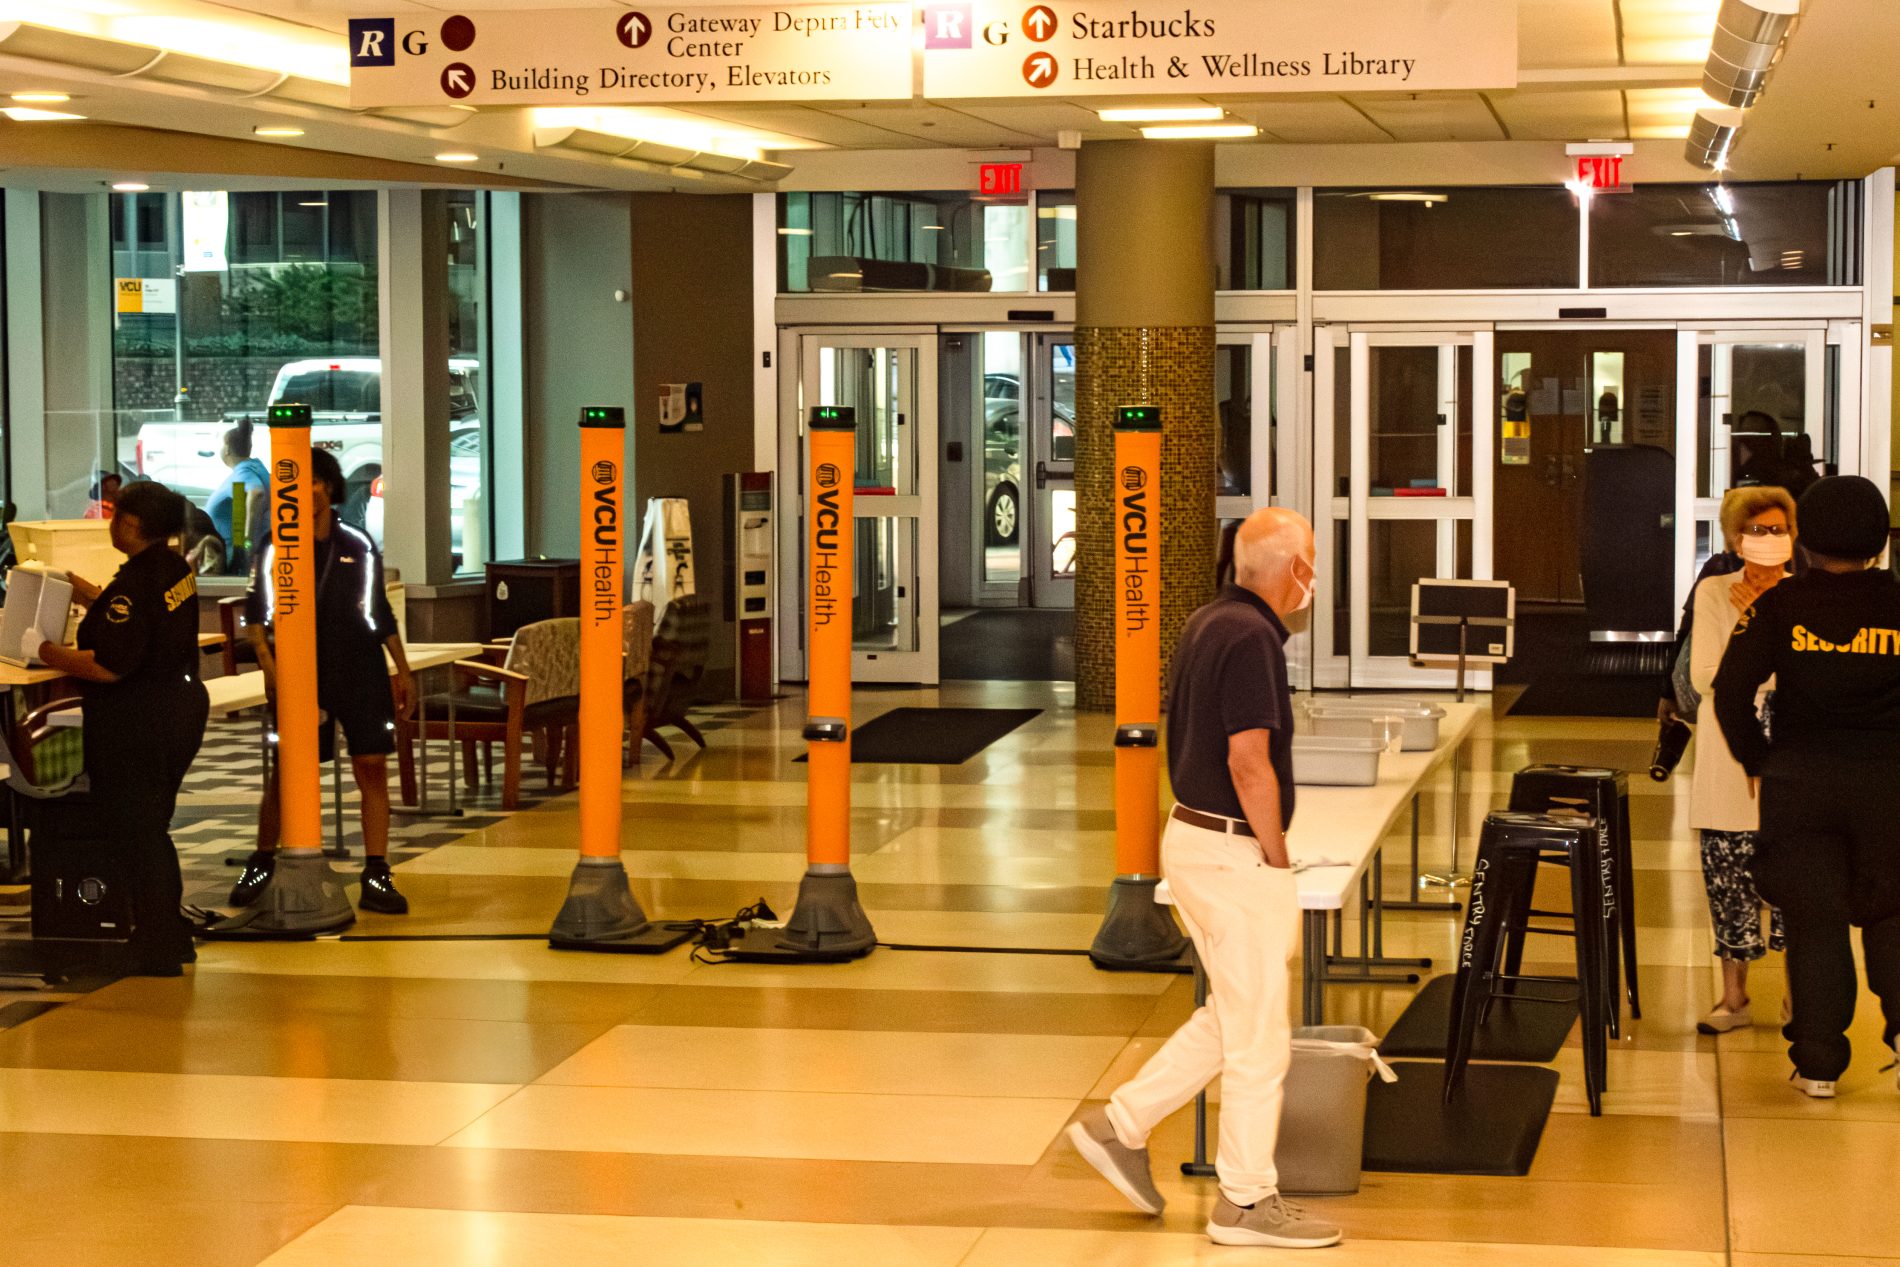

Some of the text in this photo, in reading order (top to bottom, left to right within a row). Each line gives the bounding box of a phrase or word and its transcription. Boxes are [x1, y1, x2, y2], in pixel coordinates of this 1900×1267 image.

[667, 12, 762, 38] Gateway
[935, 10, 1010, 46] R G
[1072, 9, 1216, 39] Starbucks
[357, 30, 429, 57] R G
[667, 36, 744, 58] Center
[491, 65, 831, 96] Building Directory, Elevators
[1073, 51, 1416, 81] Health & Wellness Library
[980, 163, 1022, 194] EXIT
[1578, 157, 1623, 188] EXIT
[119, 281, 141, 292] VCU
[1468, 858, 1490, 925] SENTRY
